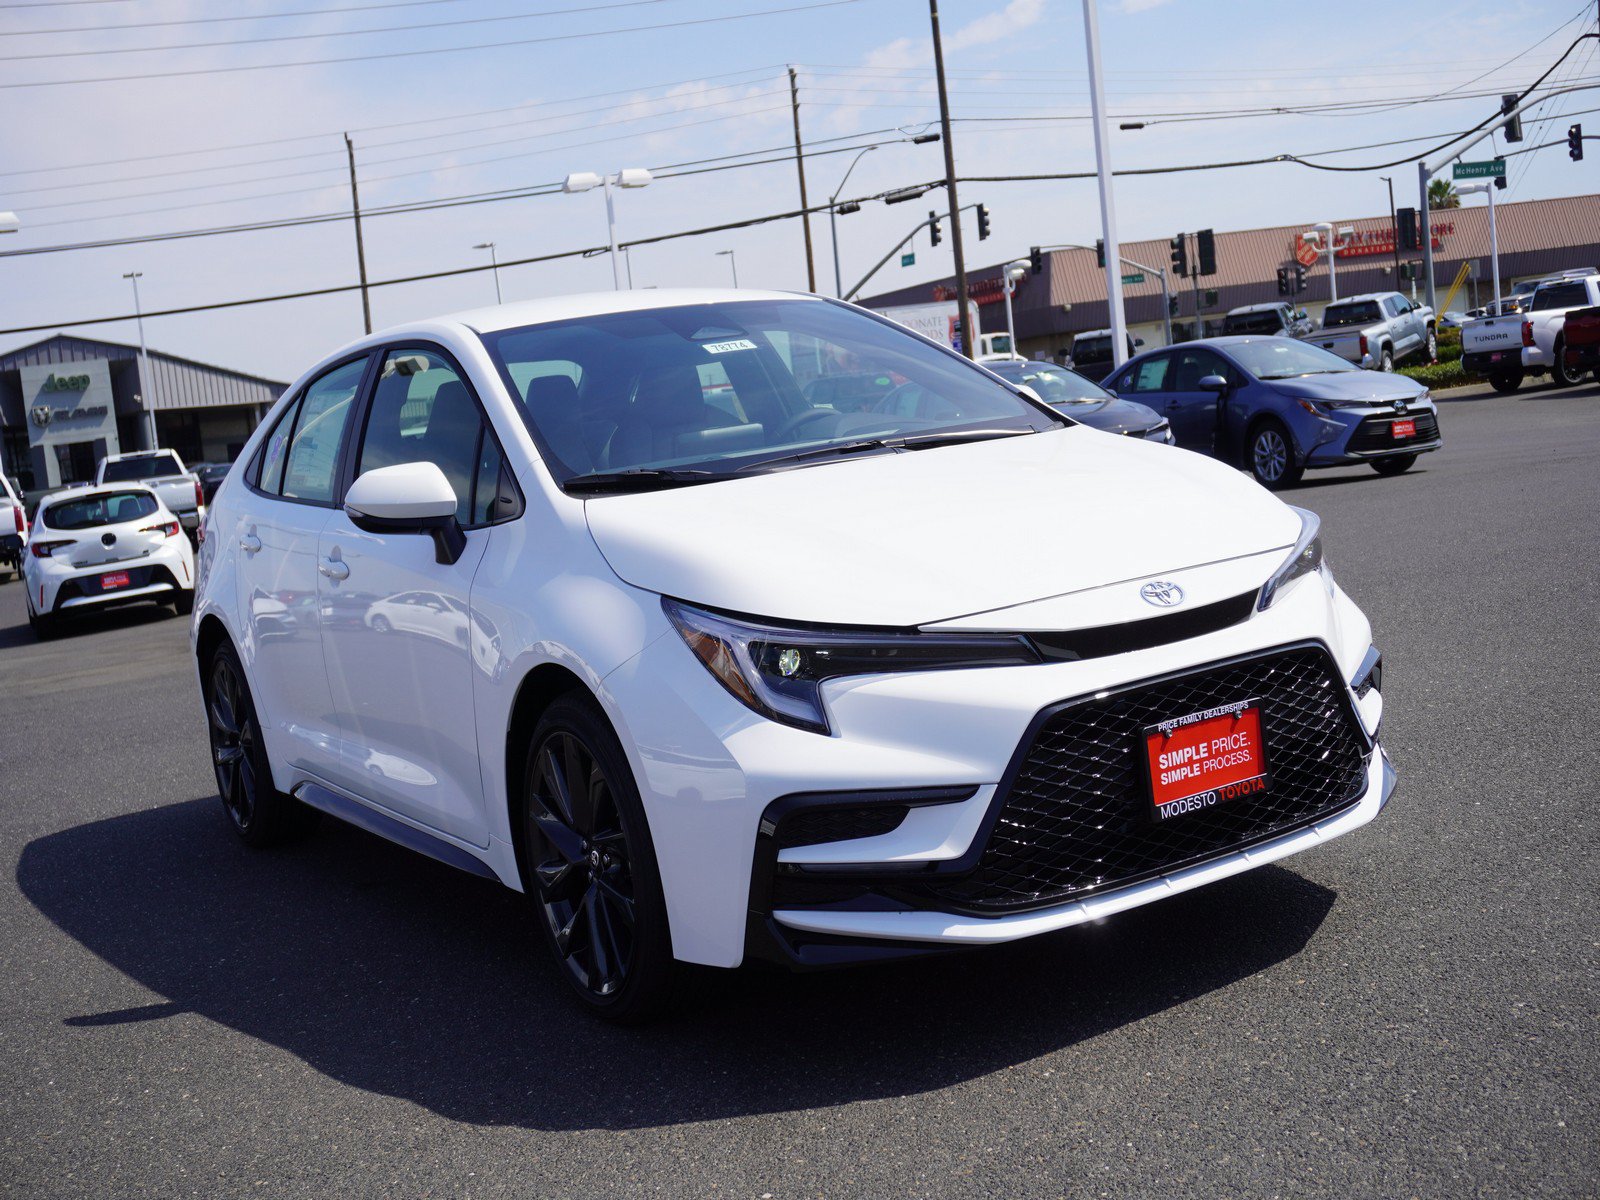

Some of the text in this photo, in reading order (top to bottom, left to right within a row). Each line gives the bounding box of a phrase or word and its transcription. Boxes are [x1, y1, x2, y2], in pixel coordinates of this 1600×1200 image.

[1455, 165, 1504, 175] McHenry Ave
[1343, 244, 1394, 255] DONATION
[711, 342, 749, 352] 78774
[1474, 333, 1508, 343] TUNDRA
[43, 373, 91, 393] Jeep
[1158, 701, 1249, 732] PRICE FAMILY DEALERSHIPS
[1159, 732, 1251, 769] SIMPLE PRICE.
[1160, 750, 1253, 785] SIMPLE PROCESS.
[1160, 777, 1265, 819] MODESTO TOYOTA
